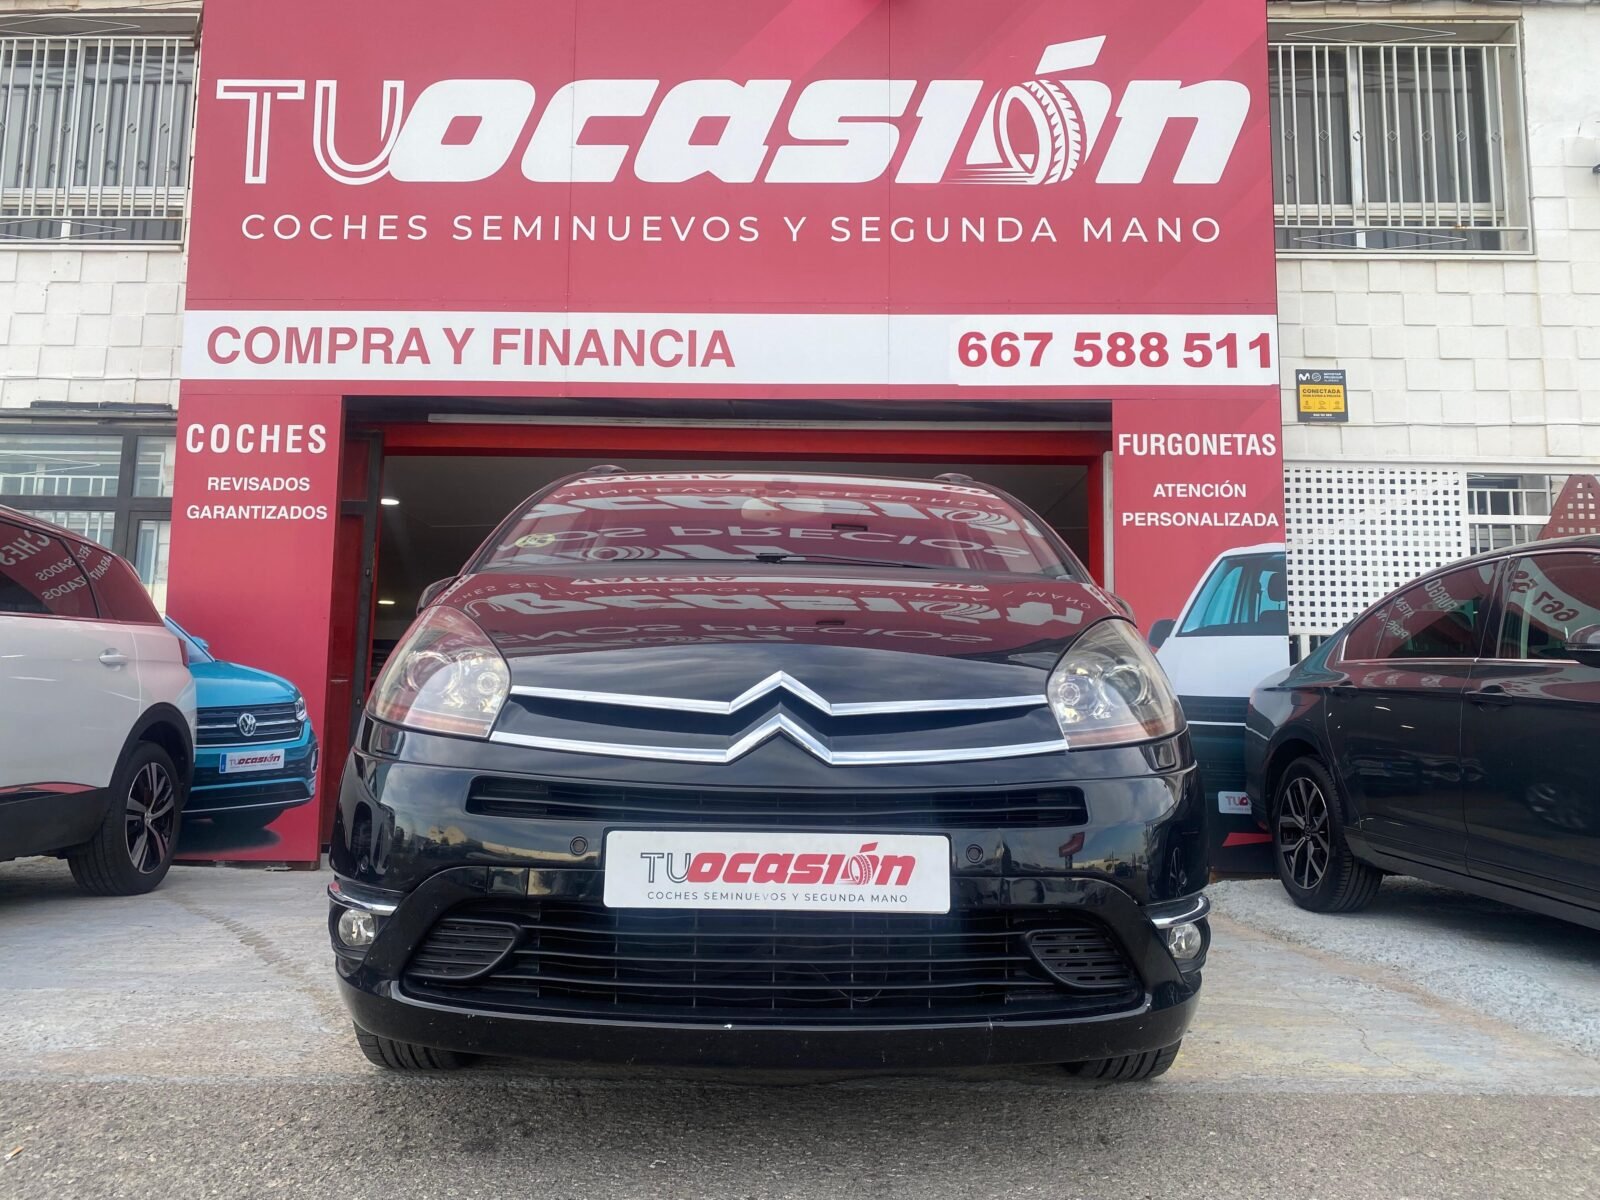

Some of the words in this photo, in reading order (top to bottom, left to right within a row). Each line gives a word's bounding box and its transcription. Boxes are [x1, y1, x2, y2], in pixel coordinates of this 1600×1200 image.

[241, 213, 428, 241] COCHES
[452, 214, 760, 242] SEMINUEVOS
[783, 216, 807, 242] Y
[830, 216, 1058, 243] SEGUNDA
[1083, 217, 1221, 243] MANO
[207, 326, 430, 365] COMPRA
[443, 327, 475, 365] Y
[492, 328, 735, 368] FINANCIA
[957, 331, 1054, 368] 667
[1073, 331, 1169, 368] 588
[1182, 332, 1272, 369] 511
[185, 423, 327, 454] COCHES
[1118, 432, 1277, 457] FURGONETAS
[207, 476, 310, 492] REVISADOS
[1153, 479, 1247, 498] ATENCIÓN
[186, 504, 328, 520] GARANTIZADOS
[1122, 511, 1279, 527] PERSONALIZADA
[647, 890, 699, 901] COCHES
[703, 891, 787, 902] SEMINUEVOS
[791, 892, 800, 901] Y
[804, 892, 865, 903] SEGUNDA
[870, 893, 908, 904] MANO
